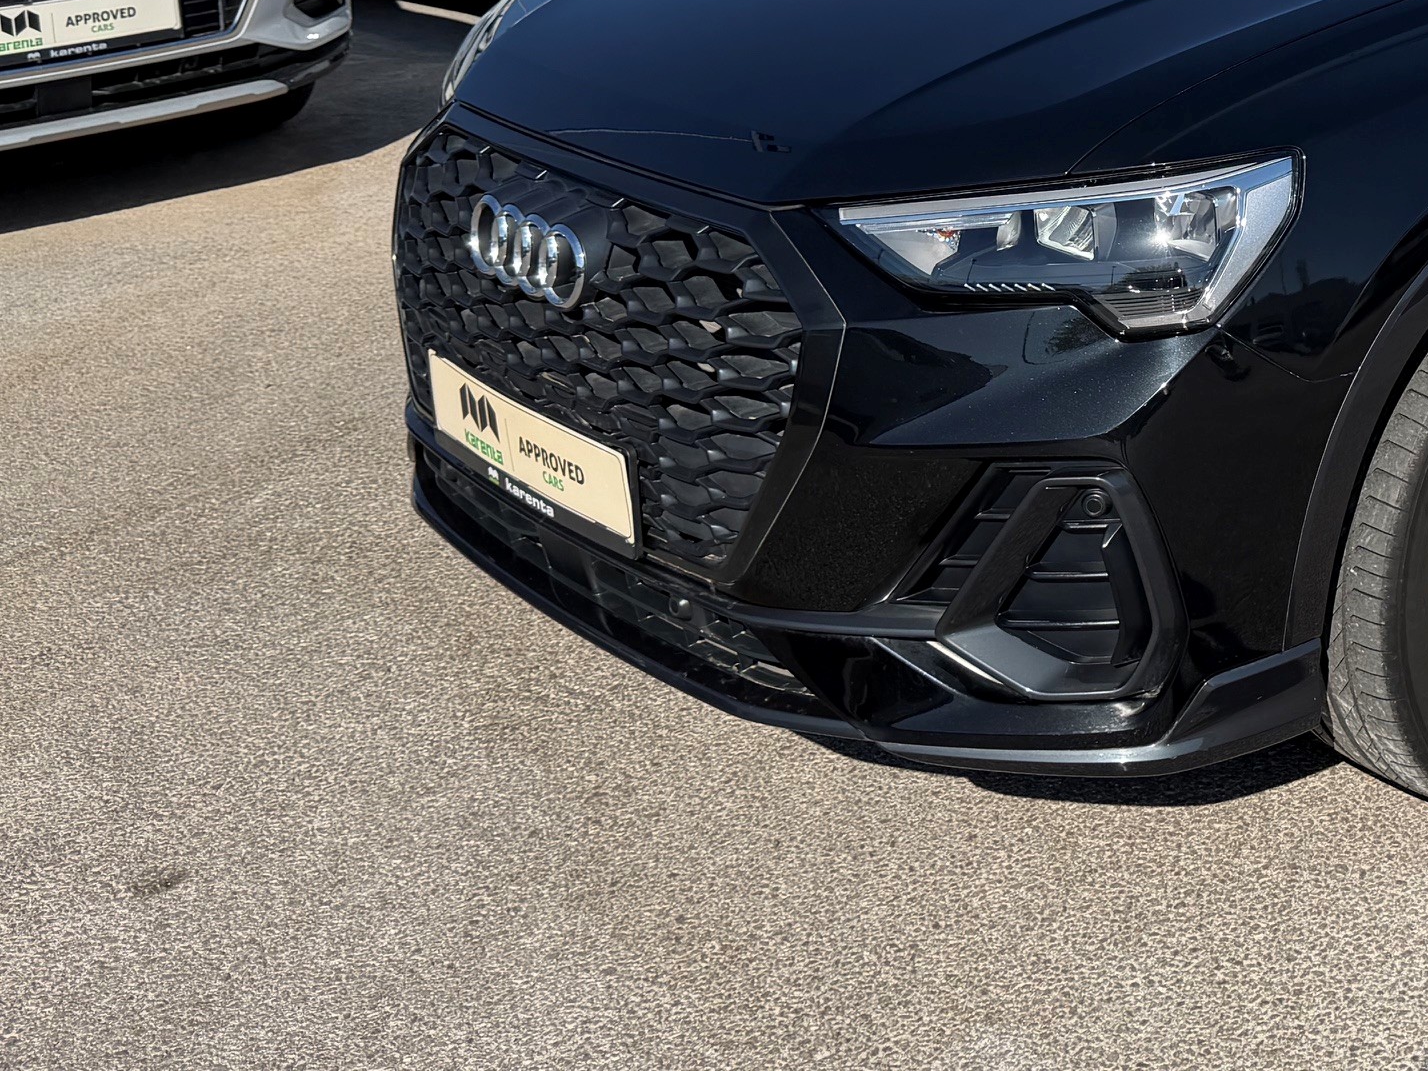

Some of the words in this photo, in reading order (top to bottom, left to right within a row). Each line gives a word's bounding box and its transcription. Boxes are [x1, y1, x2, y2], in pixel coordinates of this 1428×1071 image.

[65, 6, 136, 27] APPROVED
[91, 23, 115, 33] CARS
[0, 37, 43, 52] arenta
[51, 42, 108, 58] karenta
[464, 428, 504, 465] karenta
[518, 436, 585, 485] APPROVED
[542, 471, 564, 491] CARS
[505, 477, 554, 518] karenta
